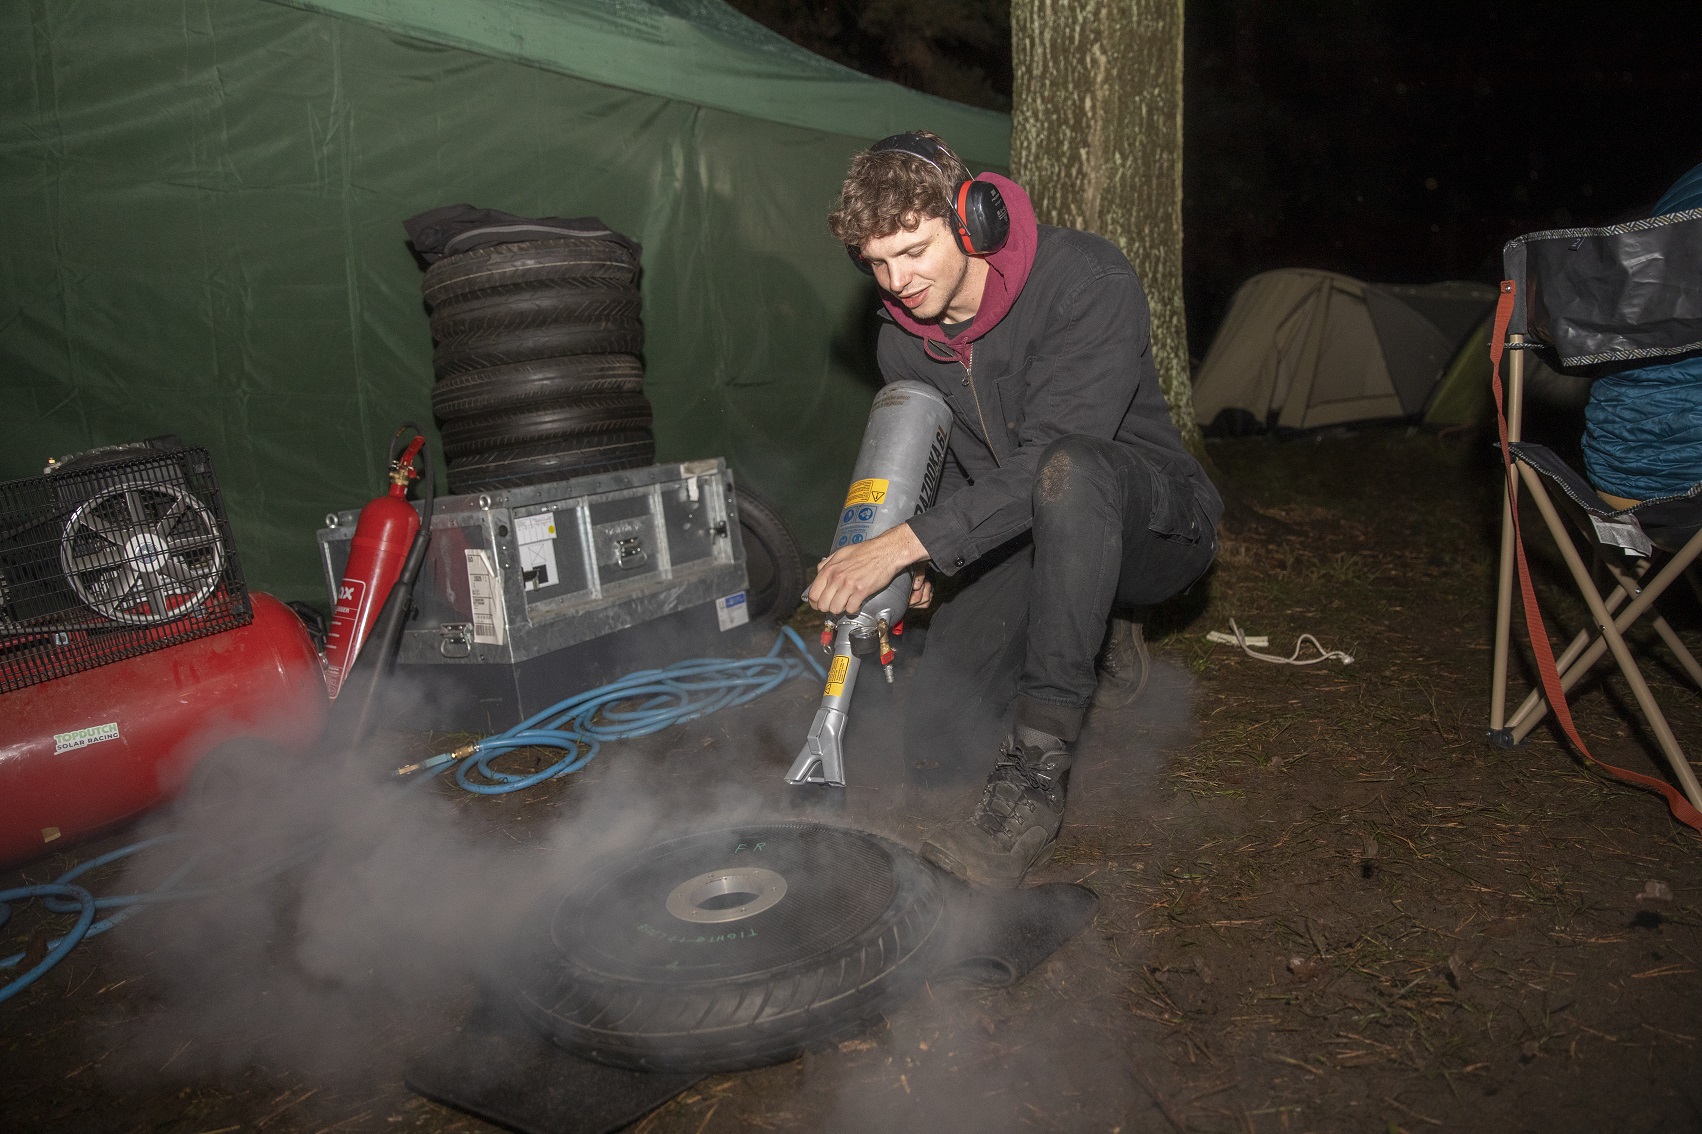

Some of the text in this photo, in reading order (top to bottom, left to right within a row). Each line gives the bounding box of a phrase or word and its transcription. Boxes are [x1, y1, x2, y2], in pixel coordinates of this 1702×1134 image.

[338, 586, 355, 600] ax
[55, 723, 117, 743] TOPDUTCH
[57, 732, 119, 751] SOLAR RACING
